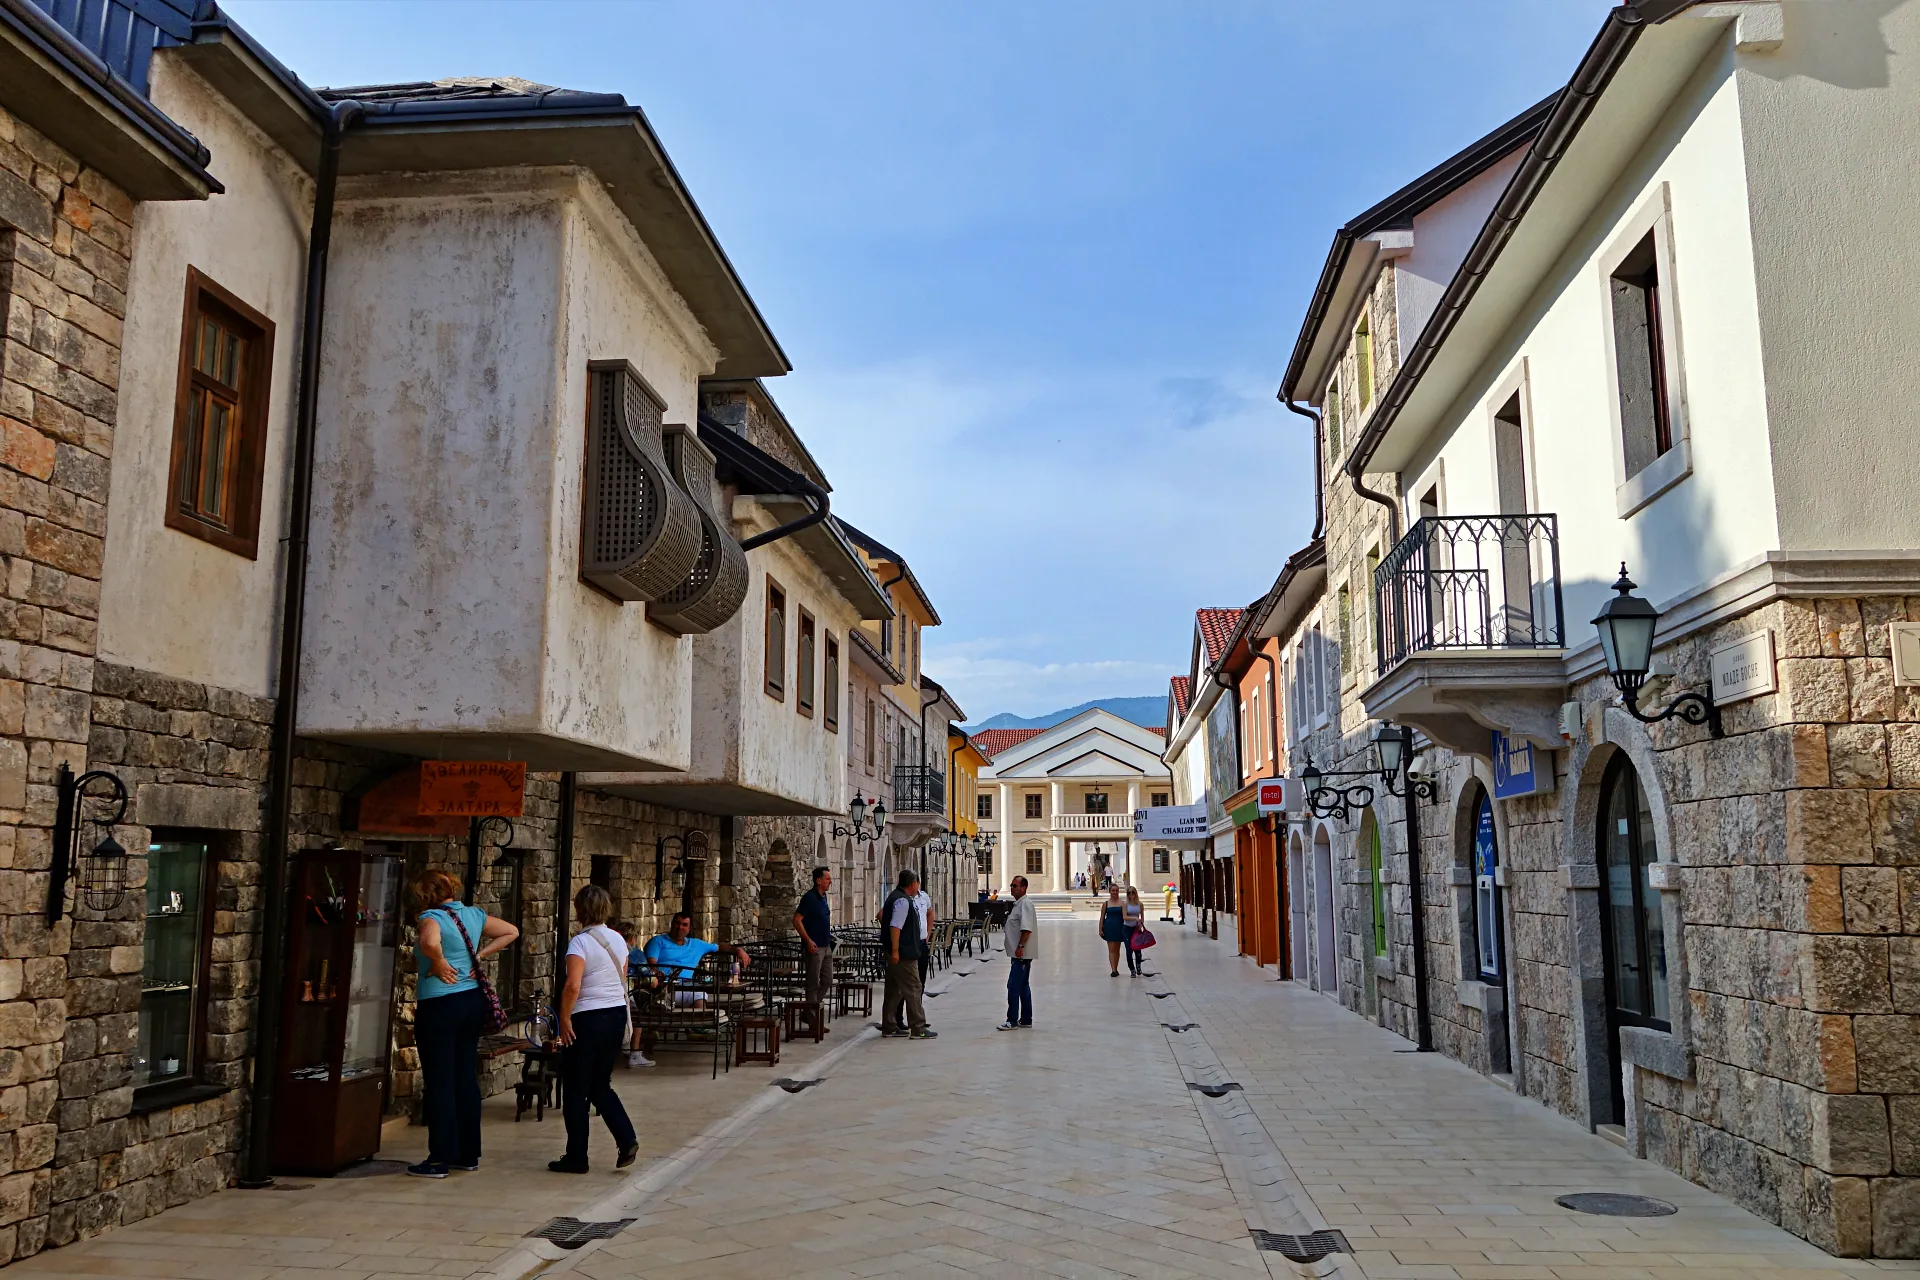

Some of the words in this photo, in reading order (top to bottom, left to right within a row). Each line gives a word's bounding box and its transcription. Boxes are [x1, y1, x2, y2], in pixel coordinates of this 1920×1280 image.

[437, 800, 501, 813] ЗЛАТАРА
[1179, 817, 1194, 825] LIAM
[1162, 826, 1195, 835] CHARLIZE
